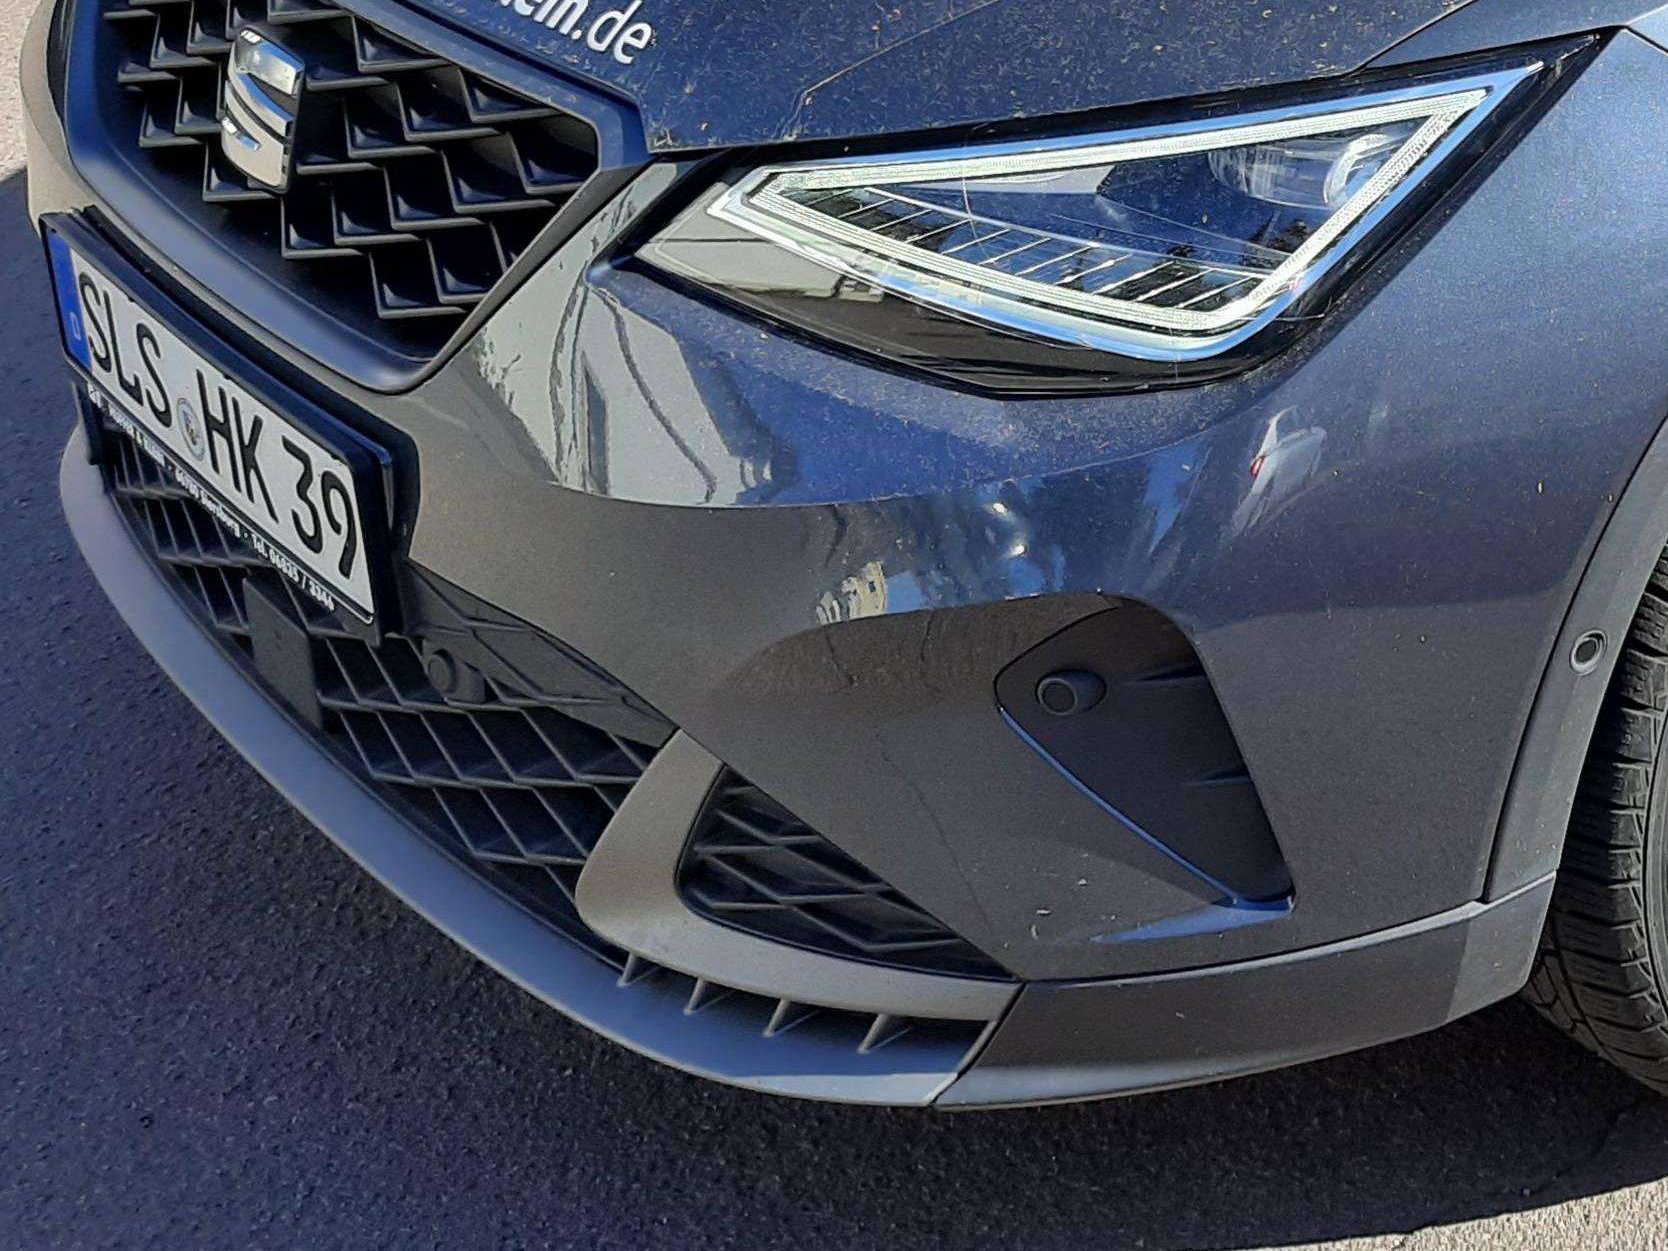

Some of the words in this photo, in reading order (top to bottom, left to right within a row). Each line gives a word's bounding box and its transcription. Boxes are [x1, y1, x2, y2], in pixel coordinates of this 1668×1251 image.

[78, 271, 172, 428] SLS
[196, 367, 280, 524] HK
[282, 434, 357, 580] 39
